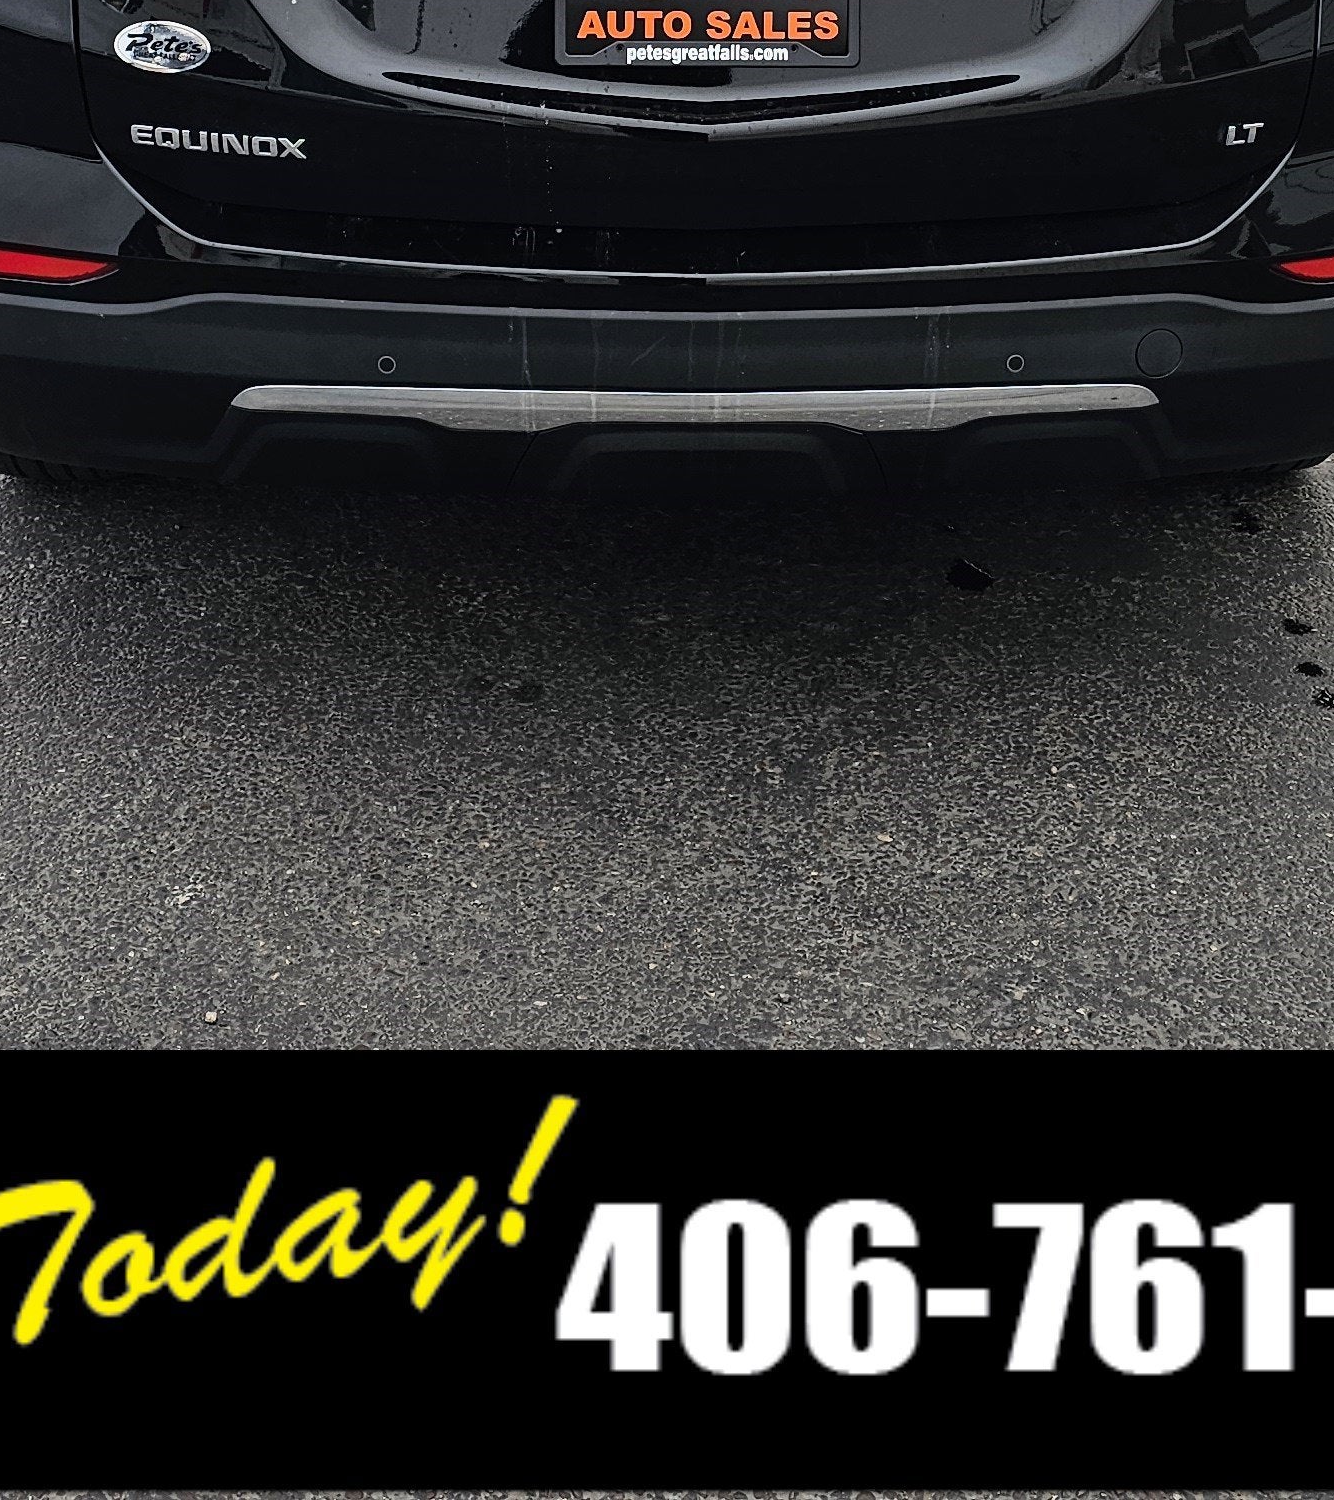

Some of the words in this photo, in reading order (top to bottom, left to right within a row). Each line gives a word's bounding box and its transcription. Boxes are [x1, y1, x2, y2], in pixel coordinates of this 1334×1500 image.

[576, 10, 692, 39] AUTO
[706, 10, 839, 40] SALES
[125, 32, 202, 53] Pete's
[625, 44, 789, 65] petesgreatfalls.com
[130, 124, 307, 160] EQUINOX
[1225, 122, 1265, 146] LT
